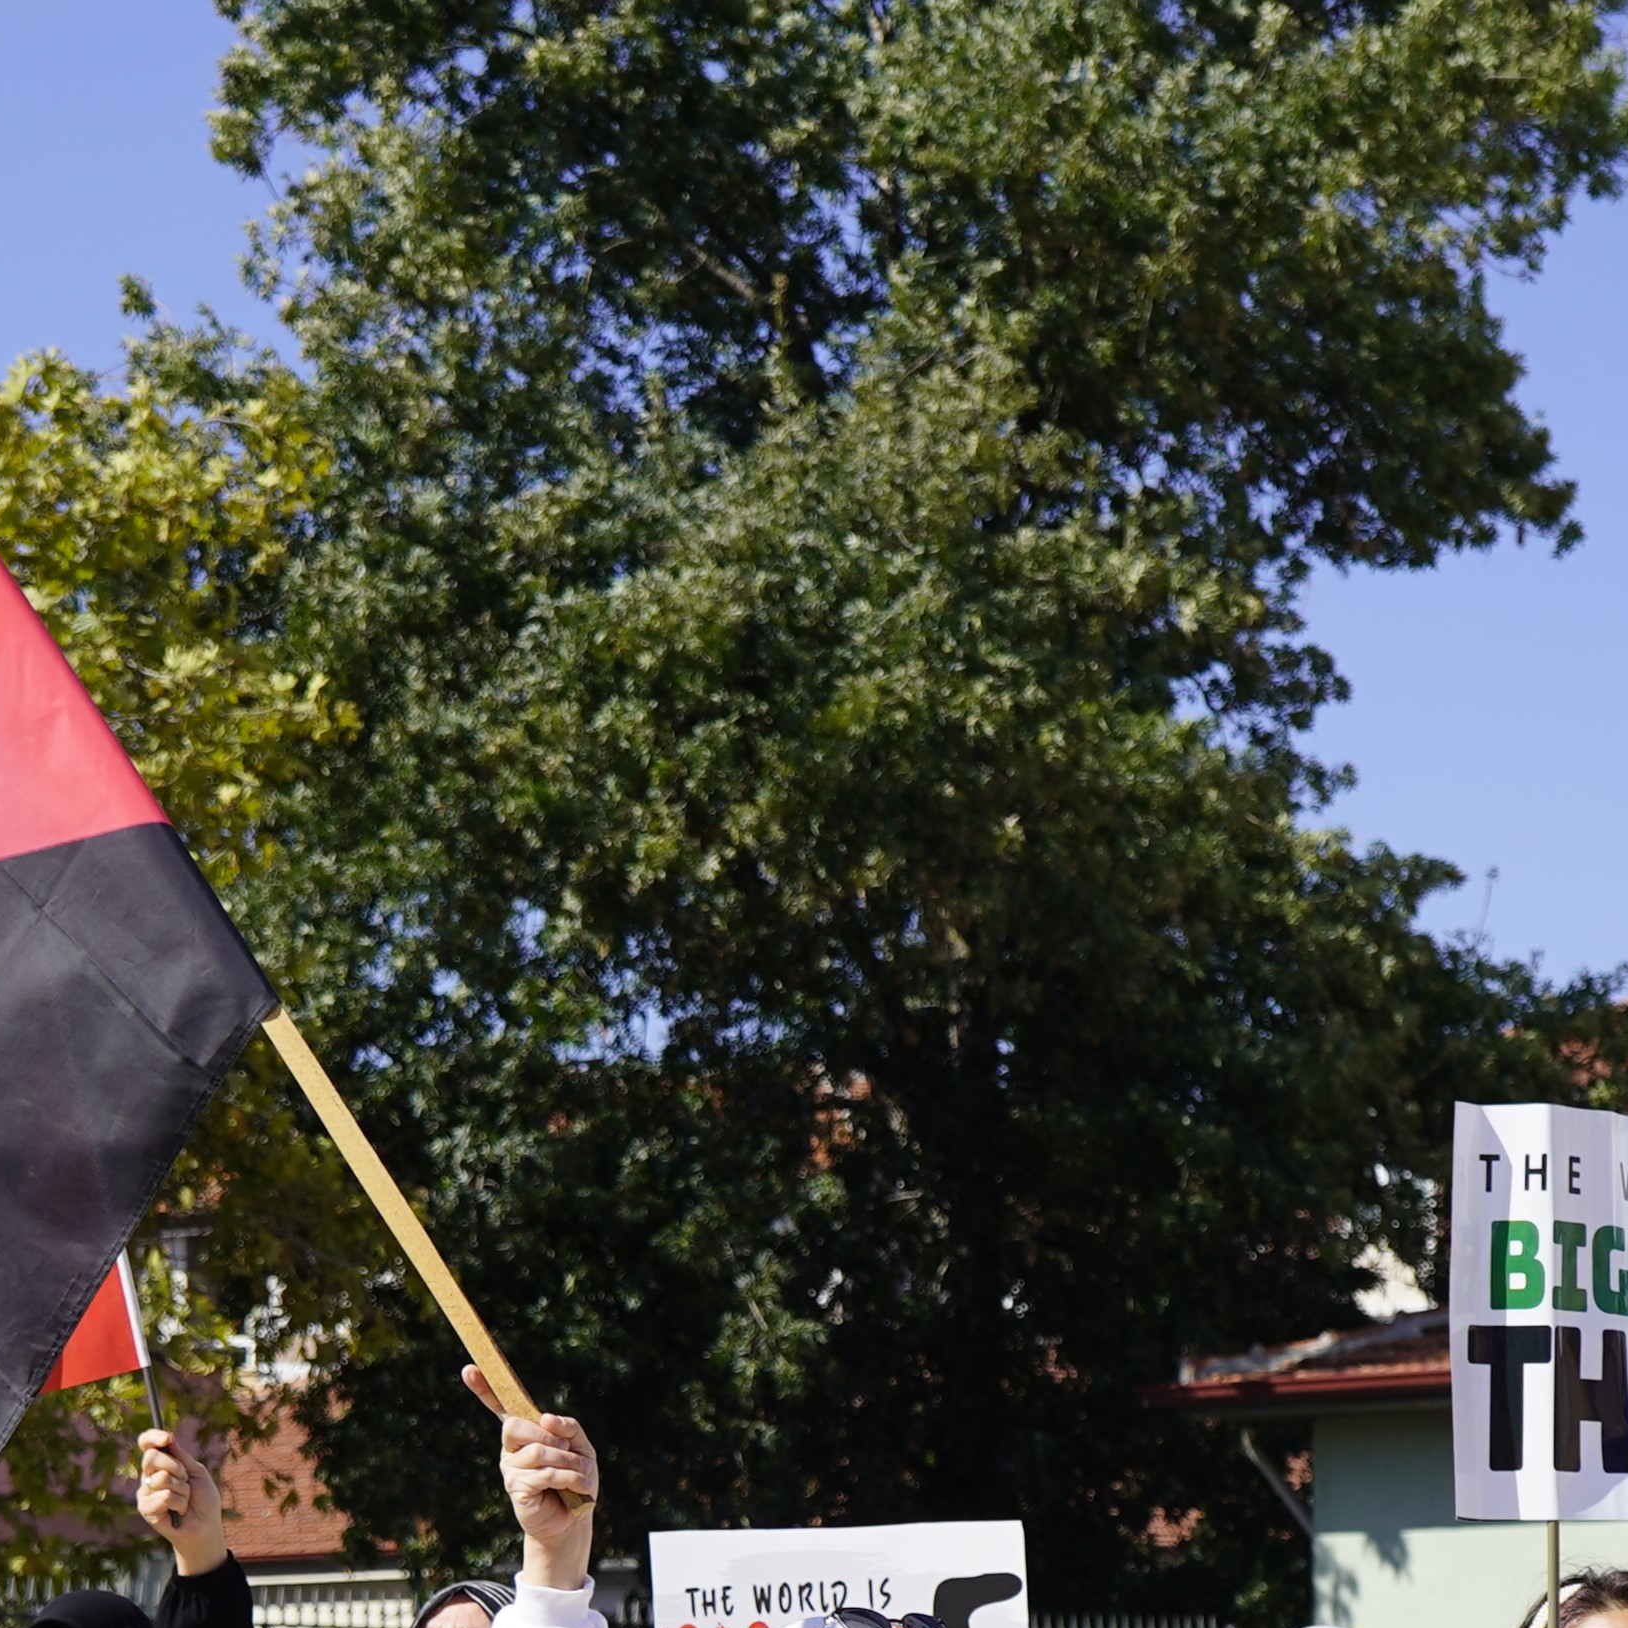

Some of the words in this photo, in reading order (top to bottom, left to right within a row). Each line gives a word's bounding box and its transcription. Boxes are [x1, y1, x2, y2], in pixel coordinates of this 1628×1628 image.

[1479, 1152, 1583, 1196] THE
[685, 1586, 734, 1618] THE
[753, 1580, 847, 1614] WORLD
[868, 1577, 892, 1608] IS
